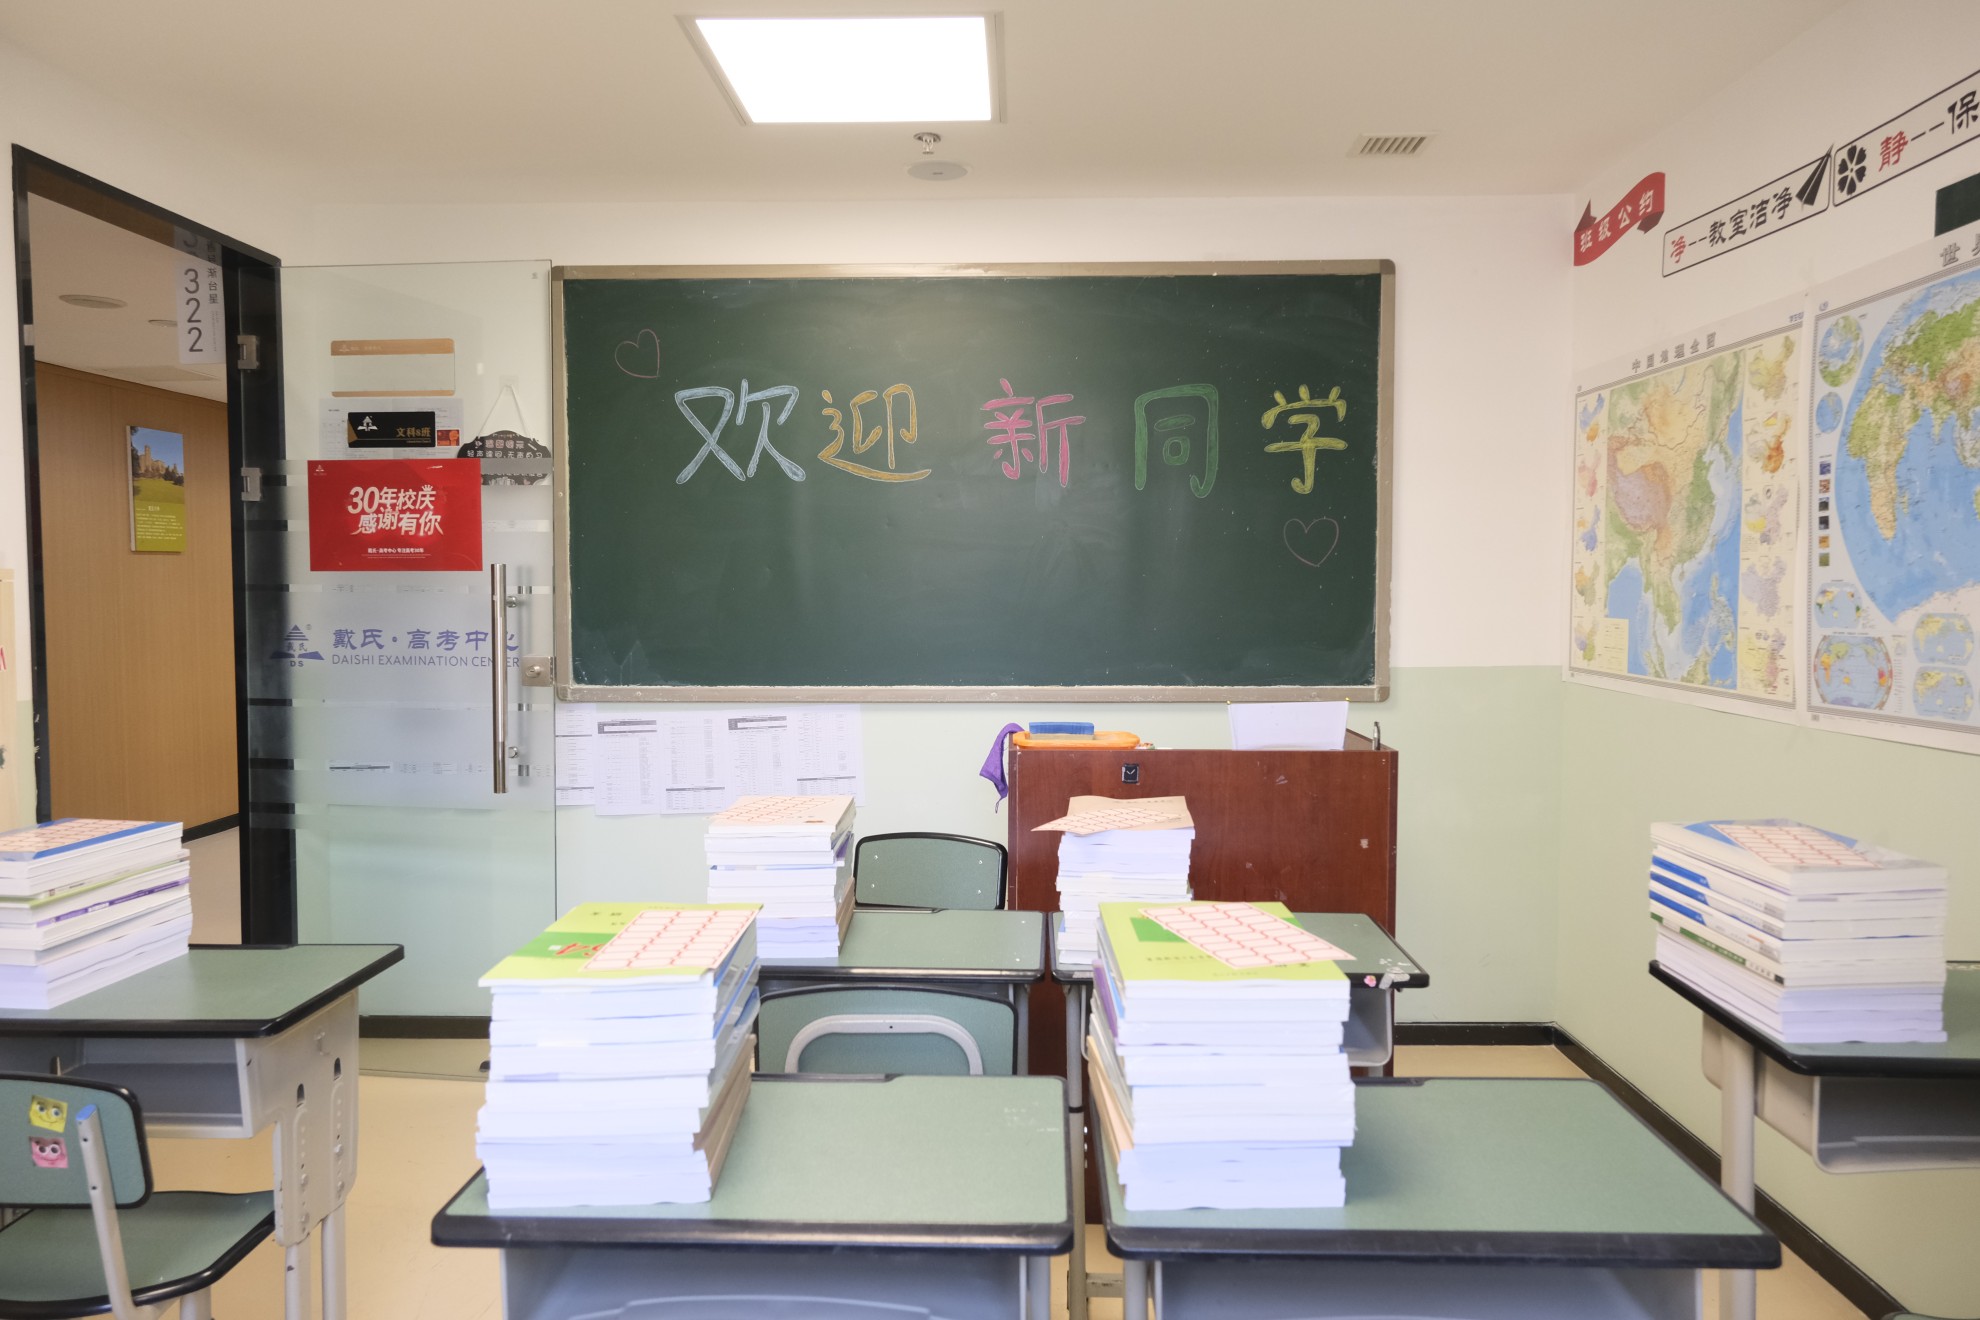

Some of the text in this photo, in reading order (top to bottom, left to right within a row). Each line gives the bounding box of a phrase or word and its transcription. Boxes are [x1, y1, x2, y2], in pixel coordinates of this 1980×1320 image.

[1580, 189, 1654, 253] 班级公约
[183, 267, 204, 353] 322
[1631, 330, 1717, 374] 中国地理全图
[674, 377, 1349, 498] 欢迎新同学
[347, 485, 436, 515] 30年校庆
[351, 506, 444, 536] 感谢有你
[332, 654, 520, 668] DAISHI EXAMINATION CENER
